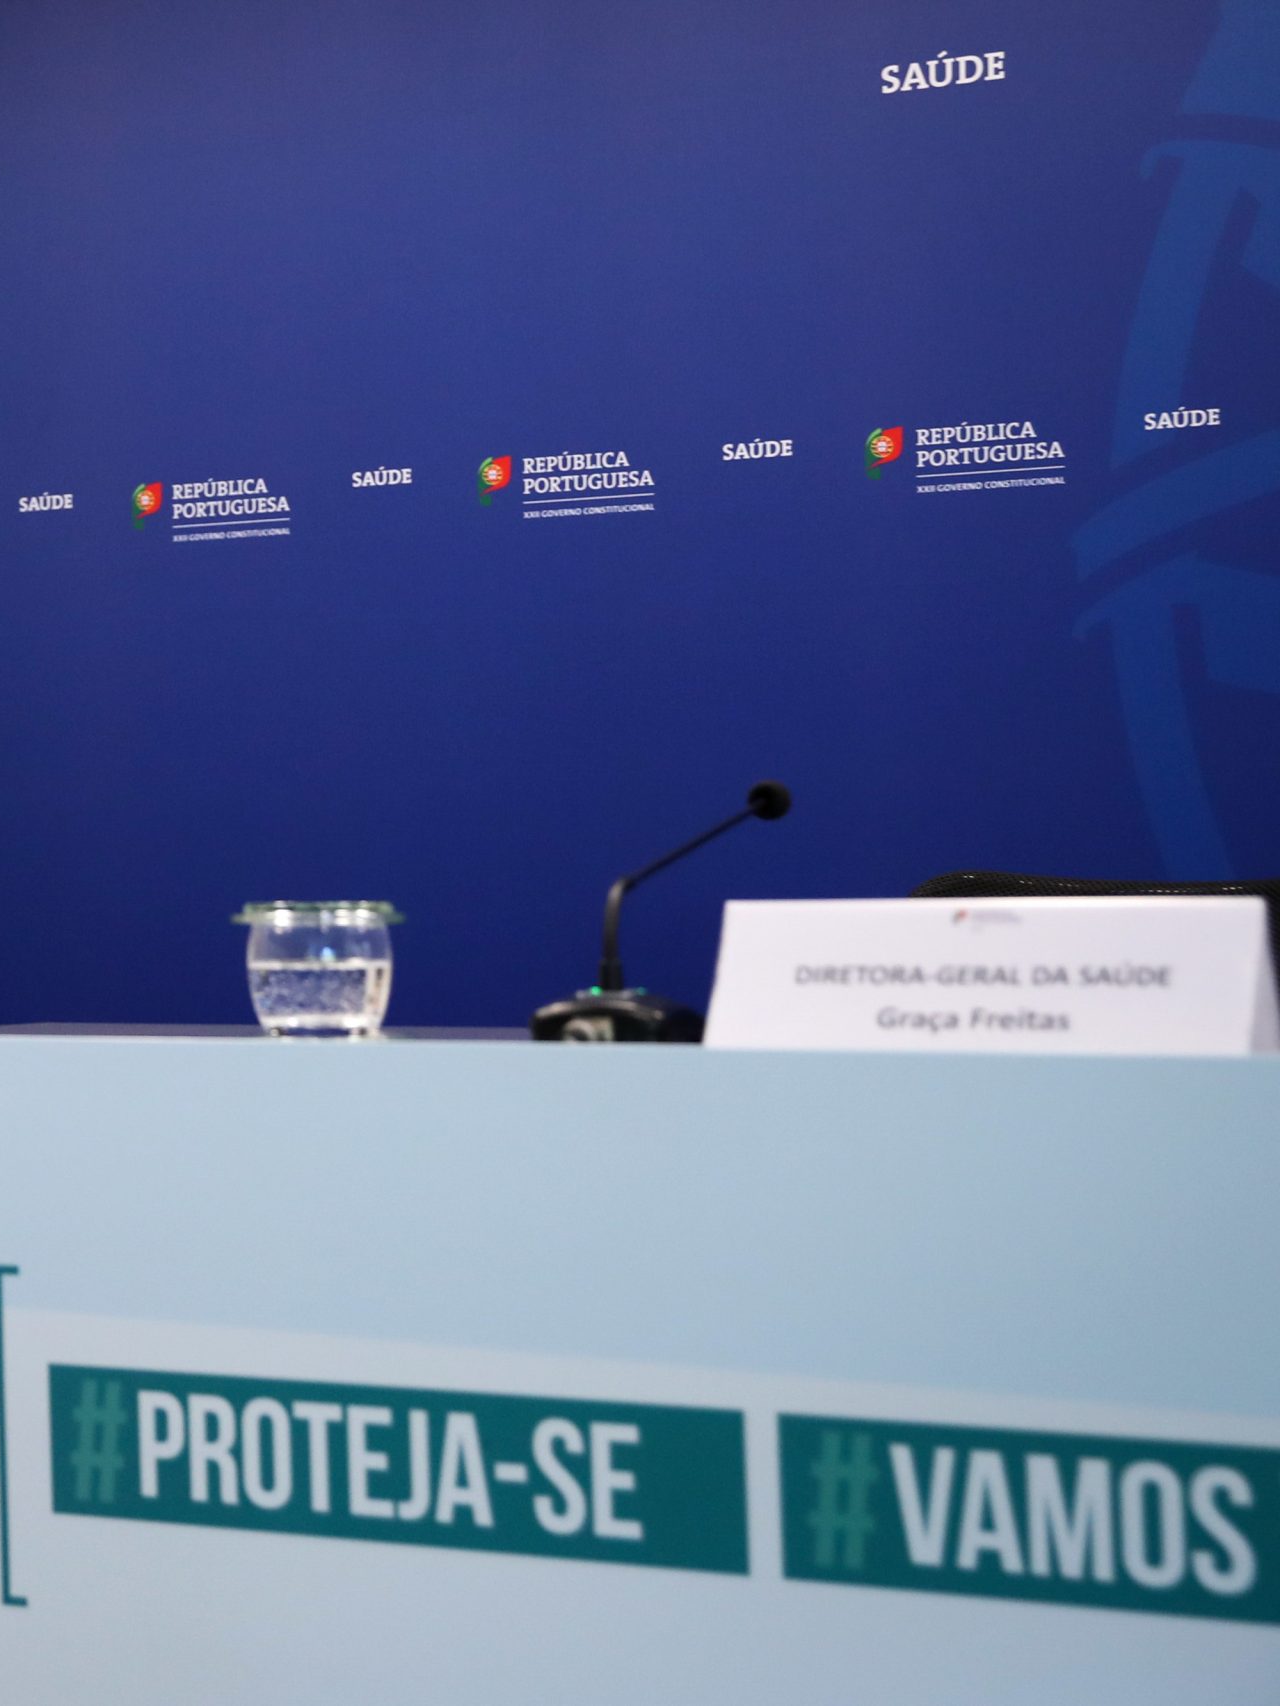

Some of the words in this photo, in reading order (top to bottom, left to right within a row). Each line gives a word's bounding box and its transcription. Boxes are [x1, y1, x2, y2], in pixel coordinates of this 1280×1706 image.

[880, 50, 1006, 94] SAÚDE
[1144, 406, 1221, 431] SAÚDE
[915, 421, 1038, 446] REPÚBLICA
[722, 438, 794, 461] SAÚDE
[916, 441, 1066, 468] PORTUGUESA
[522, 451, 631, 475] REPÚBLICA
[172, 478, 269, 500] REPÚBLICA
[351, 466, 413, 488] SAÚDE
[523, 470, 656, 495] PORTUGUESA
[937, 481, 983, 492] GOVERNO
[984, 476, 1066, 490] CONSTITUCIONAL
[19, 492, 74, 513] SAÚDE
[172, 496, 291, 520] PORTUGUESA
[541, 507, 582, 518] GOVERNO
[583, 503, 656, 515] CONSTITUCIONAL
[188, 531, 226, 541] GOVERNO
[794, 963, 1021, 988] DIRETORA-GERAL
[1032, 964, 1068, 987] DA
[1078, 959, 1173, 988] SAÚDE
[875, 1006, 960, 1034] Graça
[969, 1007, 1071, 1032] Freitas
[70, 1378, 645, 1543] #PROTEJA-SE
[810, 1430, 1257, 1597] #VAMOS
